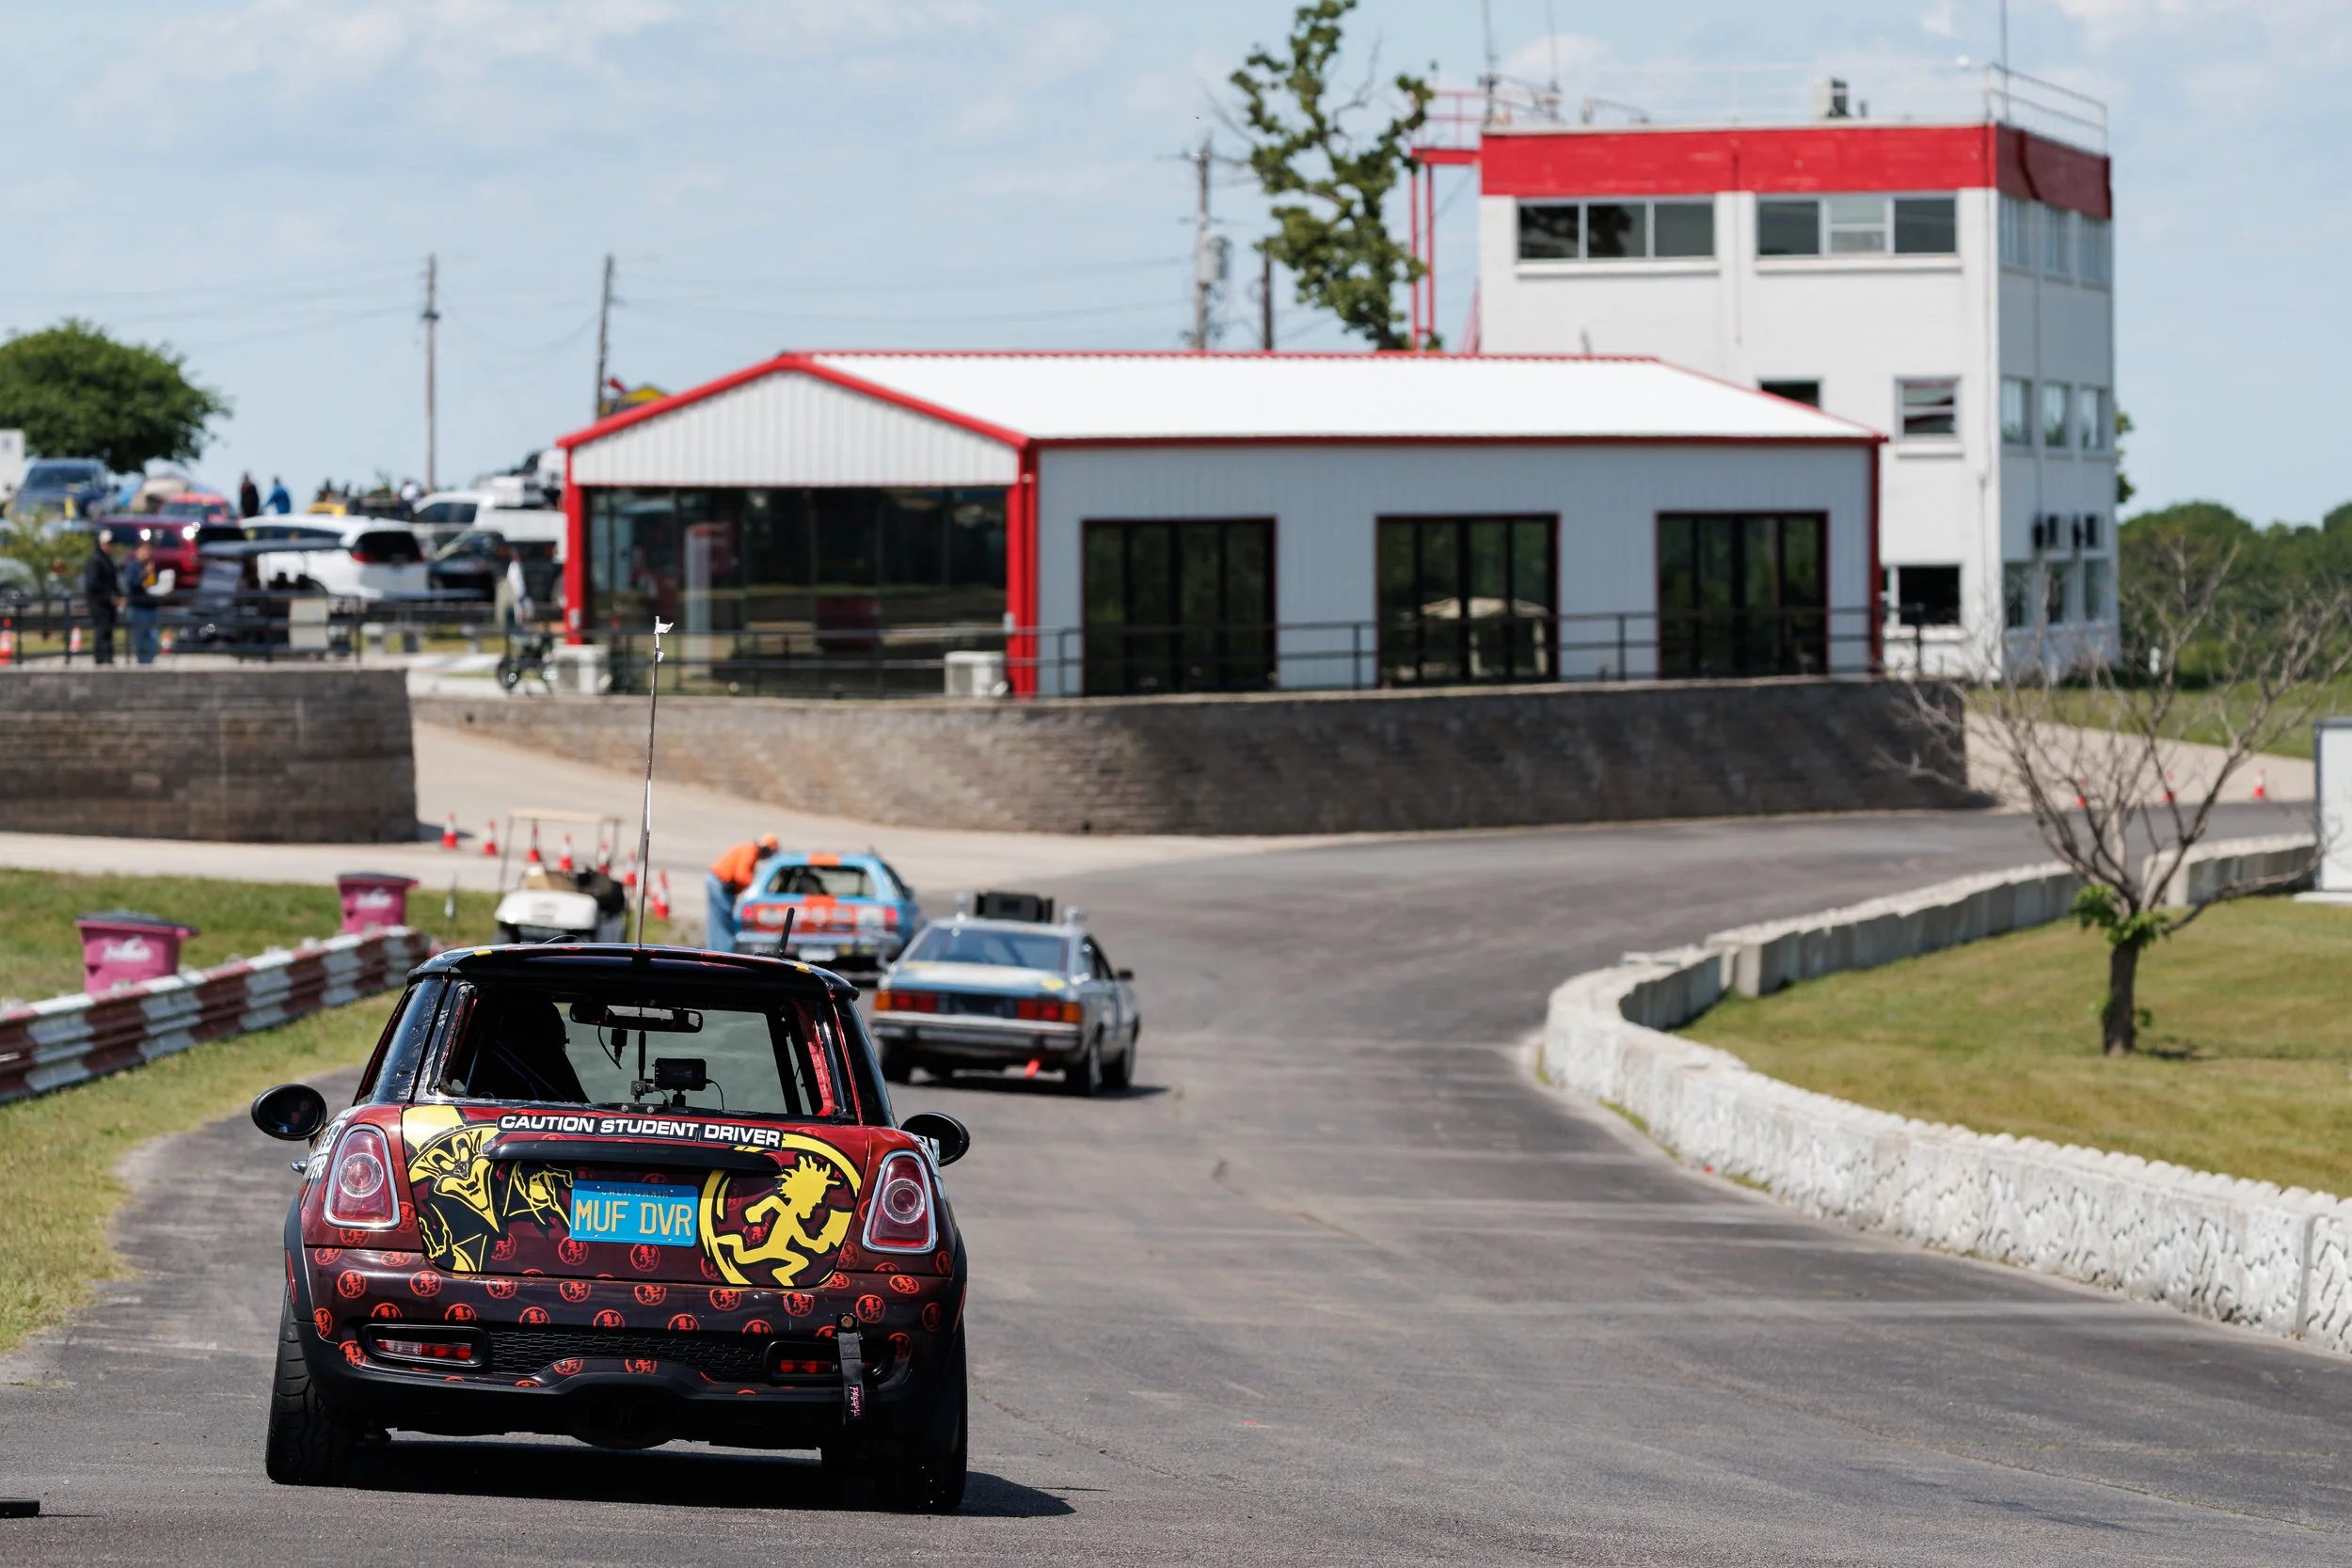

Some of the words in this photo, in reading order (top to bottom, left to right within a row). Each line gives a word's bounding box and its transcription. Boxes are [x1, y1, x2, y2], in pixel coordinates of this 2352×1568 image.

[501, 1115, 594, 1133] CAUTION
[600, 1119, 699, 1137] STUDENT
[704, 1124, 780, 1148] DRIVER
[575, 1199, 629, 1232] MUF
[640, 1202, 692, 1237] DVR
